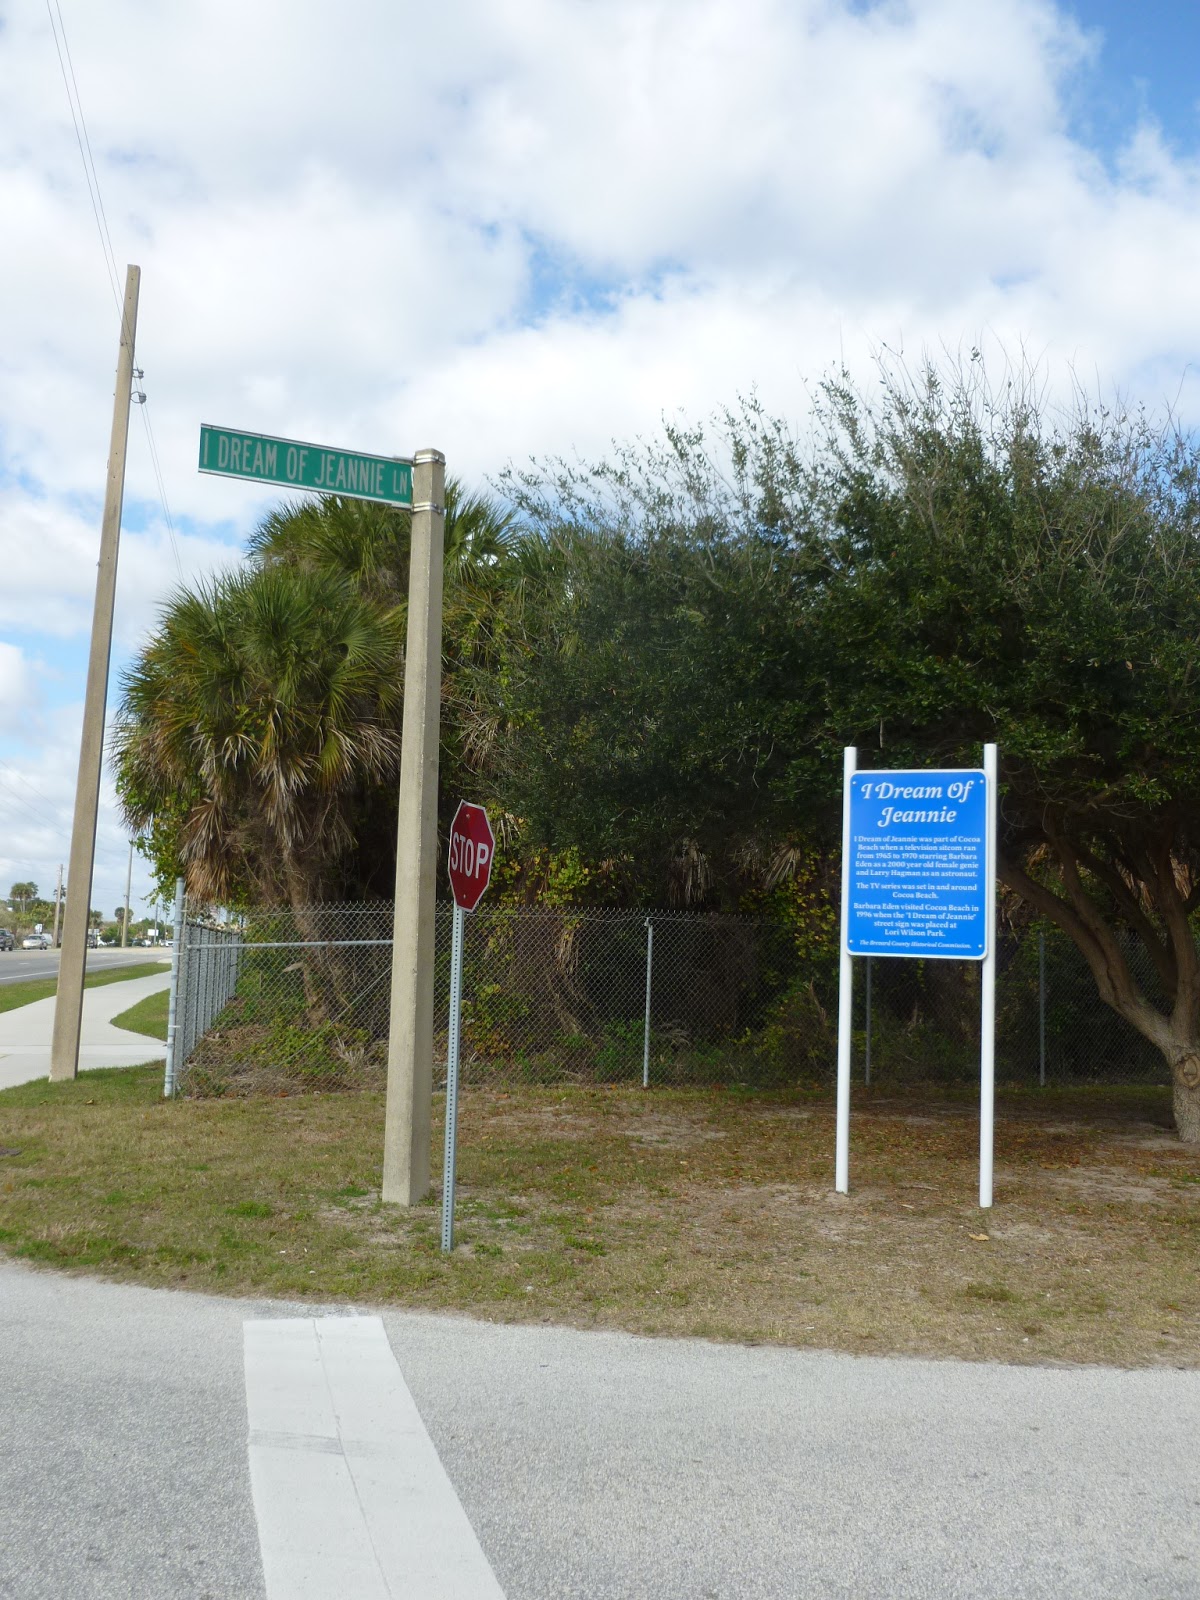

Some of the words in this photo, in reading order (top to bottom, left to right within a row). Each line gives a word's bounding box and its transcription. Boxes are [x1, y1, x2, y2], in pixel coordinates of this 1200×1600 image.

[204, 432, 208, 465] I
[218, 436, 277, 477] DREAM
[287, 447, 308, 481] OF
[315, 454, 384, 495] JEANNIE
[393, 470, 407, 495] LN
[861, 783, 872, 798] I
[875, 782, 942, 798] Dream
[947, 780, 974, 803] Of
[878, 806, 957, 827] Jeannie
[451, 832, 489, 878] STOP
